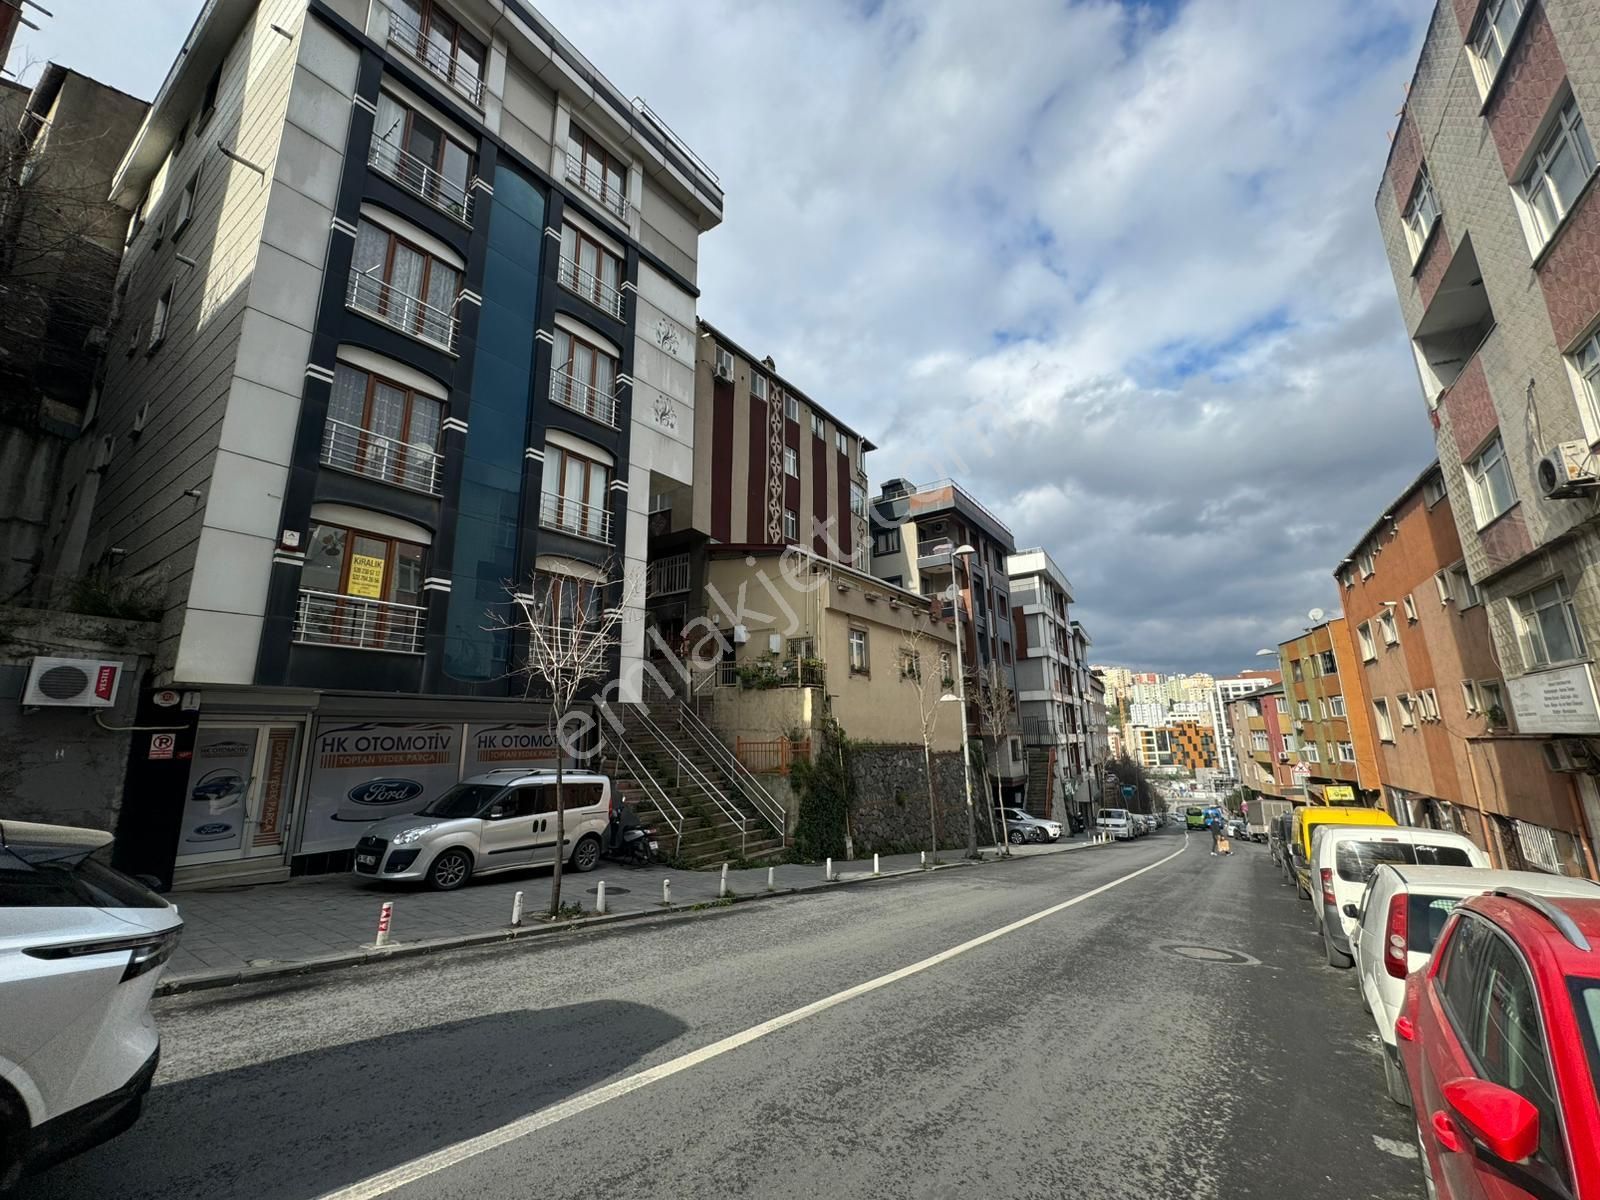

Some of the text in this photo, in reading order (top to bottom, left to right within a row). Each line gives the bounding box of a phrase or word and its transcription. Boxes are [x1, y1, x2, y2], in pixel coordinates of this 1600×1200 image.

[320, 732, 451, 753] HK OTOMOTİV
[477, 735, 497, 749] HK
[272, 742, 286, 774] TOPTAN
[338, 753, 436, 765] TOPTAN YEDEK PARÇA
[269, 775, 282, 801] YEDEK
[363, 782, 409, 802] Ford
